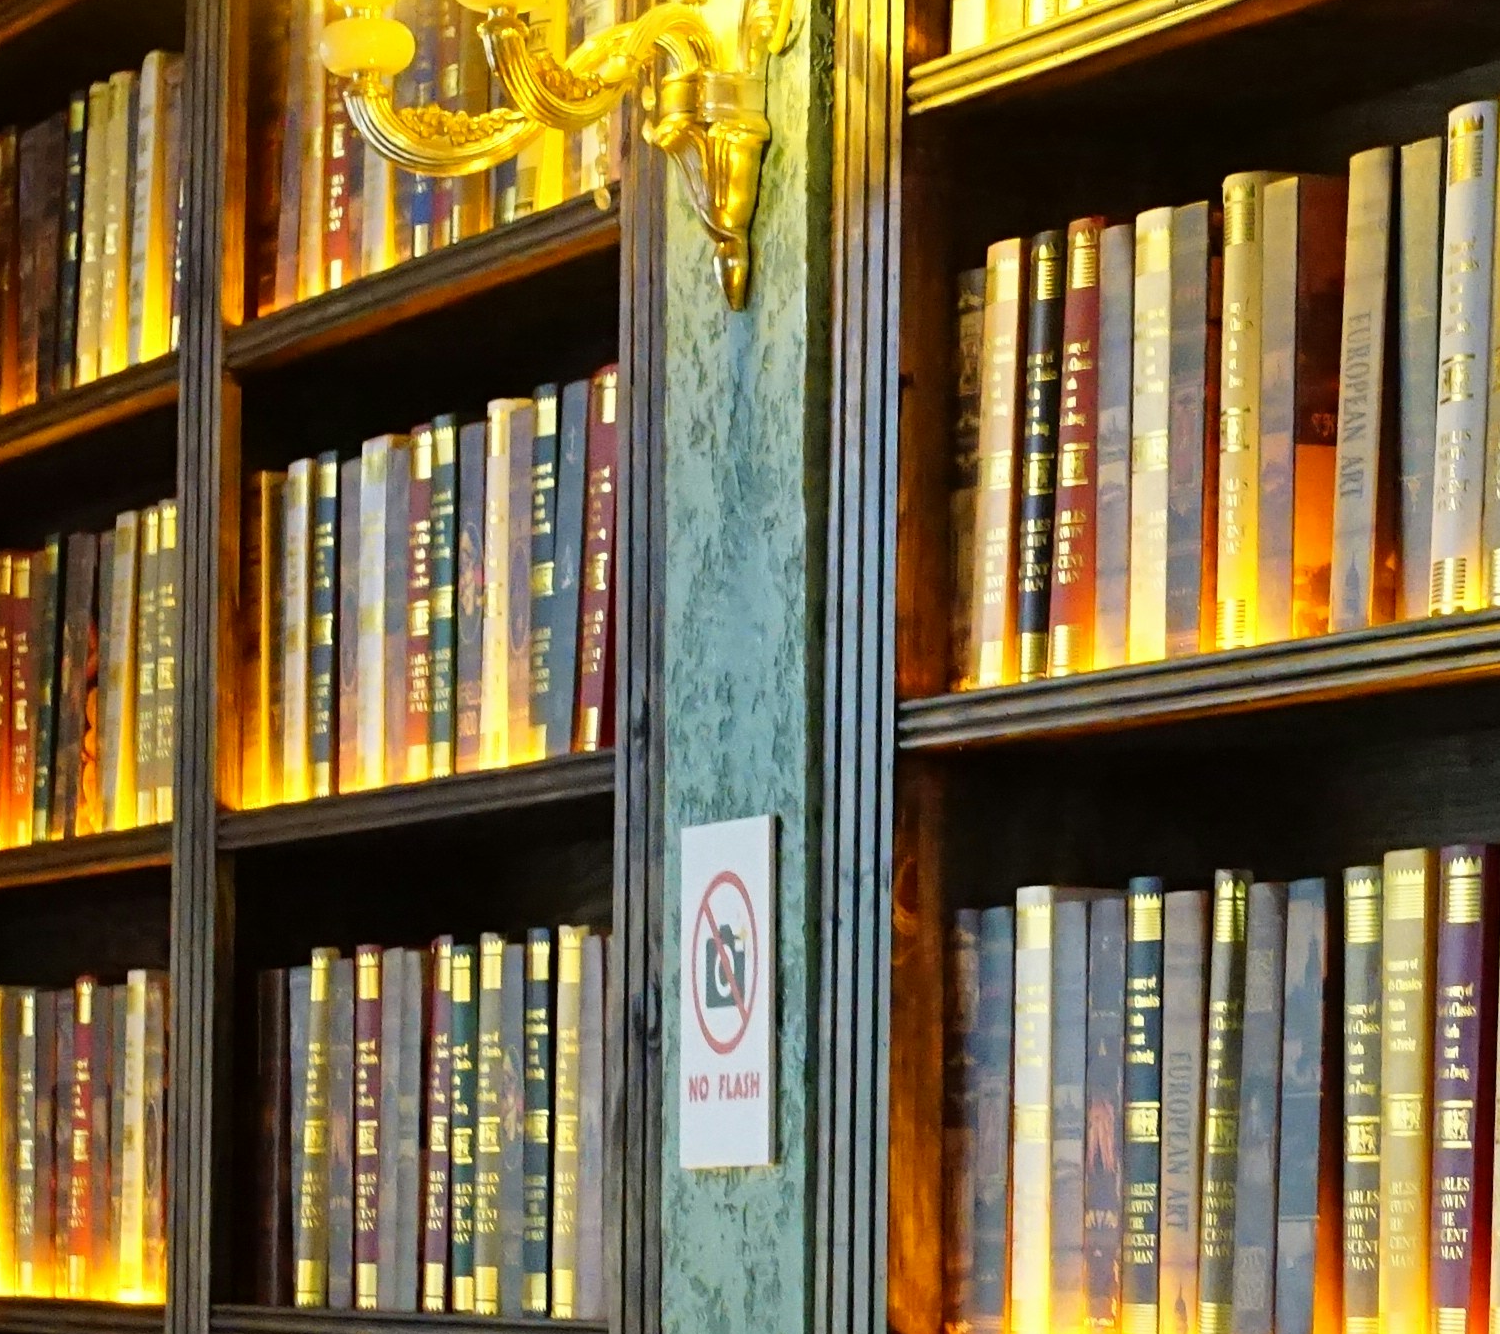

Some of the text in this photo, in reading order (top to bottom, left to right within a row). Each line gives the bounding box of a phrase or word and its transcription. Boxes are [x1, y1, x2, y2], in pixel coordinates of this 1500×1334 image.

[1339, 310, 1372, 499] EUROPEAN ART
[687, 1070, 761, 1102] NO FLASH
[1166, 1052, 1192, 1232] EUROPEAN ART
